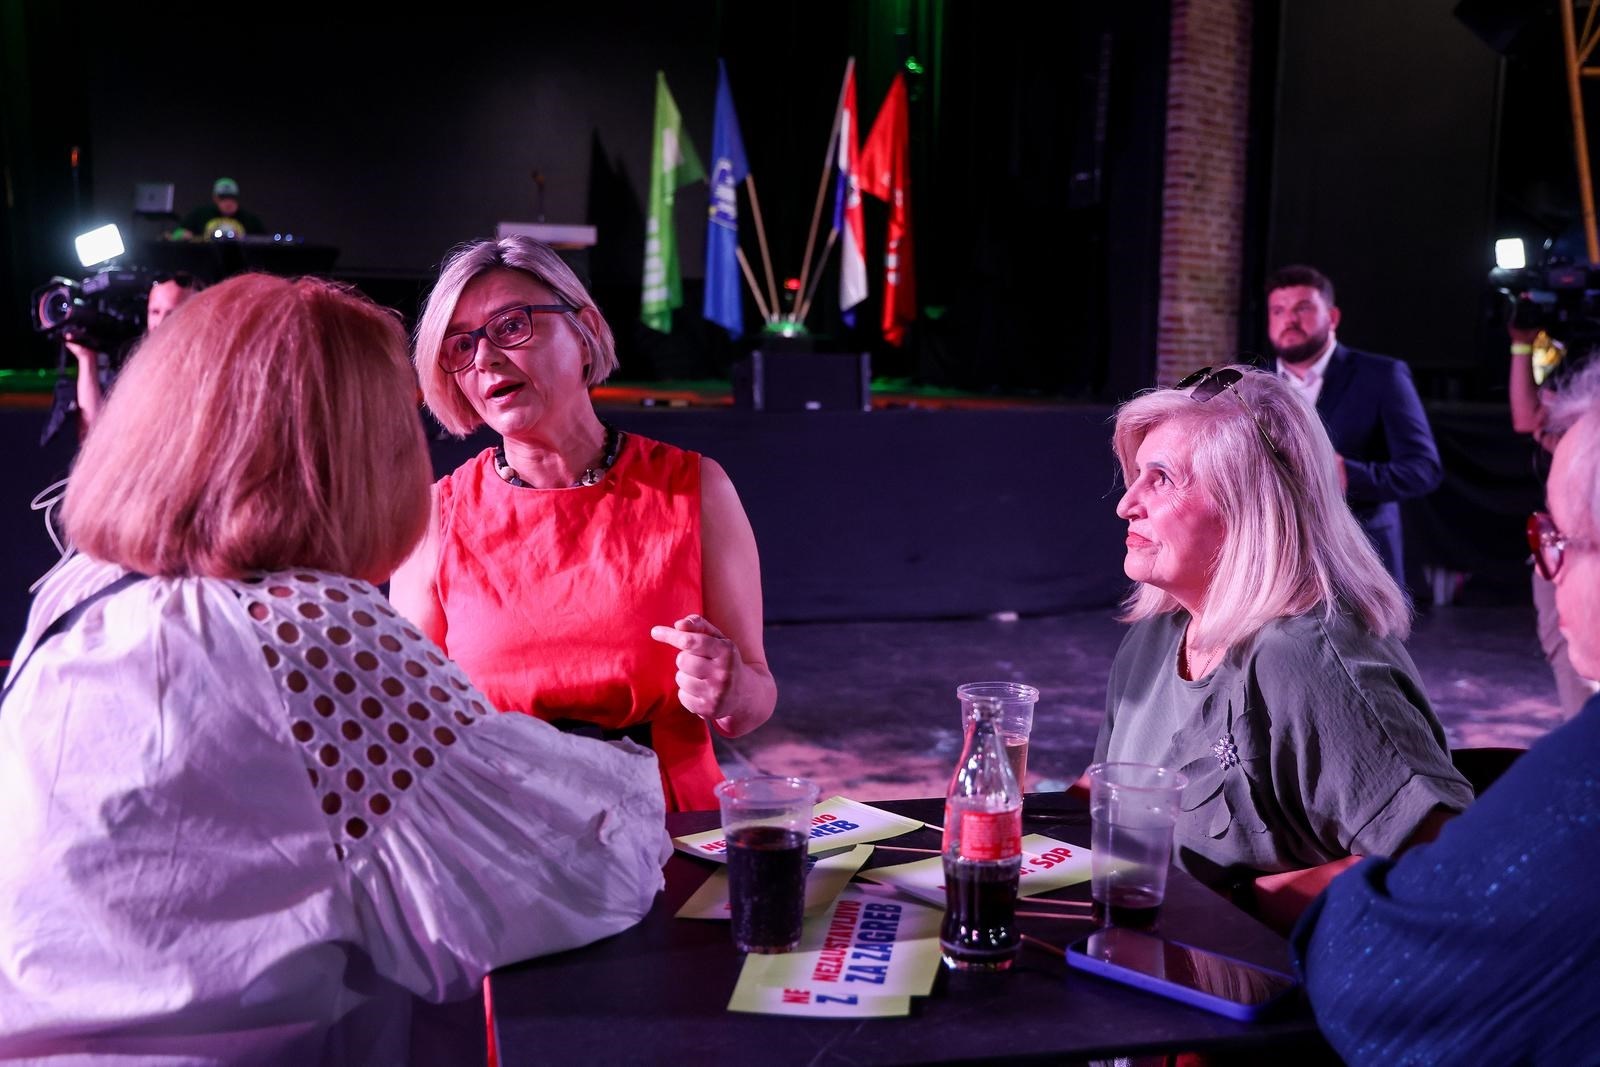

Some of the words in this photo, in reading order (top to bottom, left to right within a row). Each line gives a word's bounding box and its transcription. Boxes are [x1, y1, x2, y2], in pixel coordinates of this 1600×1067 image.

[808, 820, 860, 838] REB
[1029, 847, 1073, 869] SDP
[812, 900, 862, 982] NEZAUSTAVLJIVO
[851, 903, 902, 962] ZAGREB
[844, 965, 888, 984] ZA
